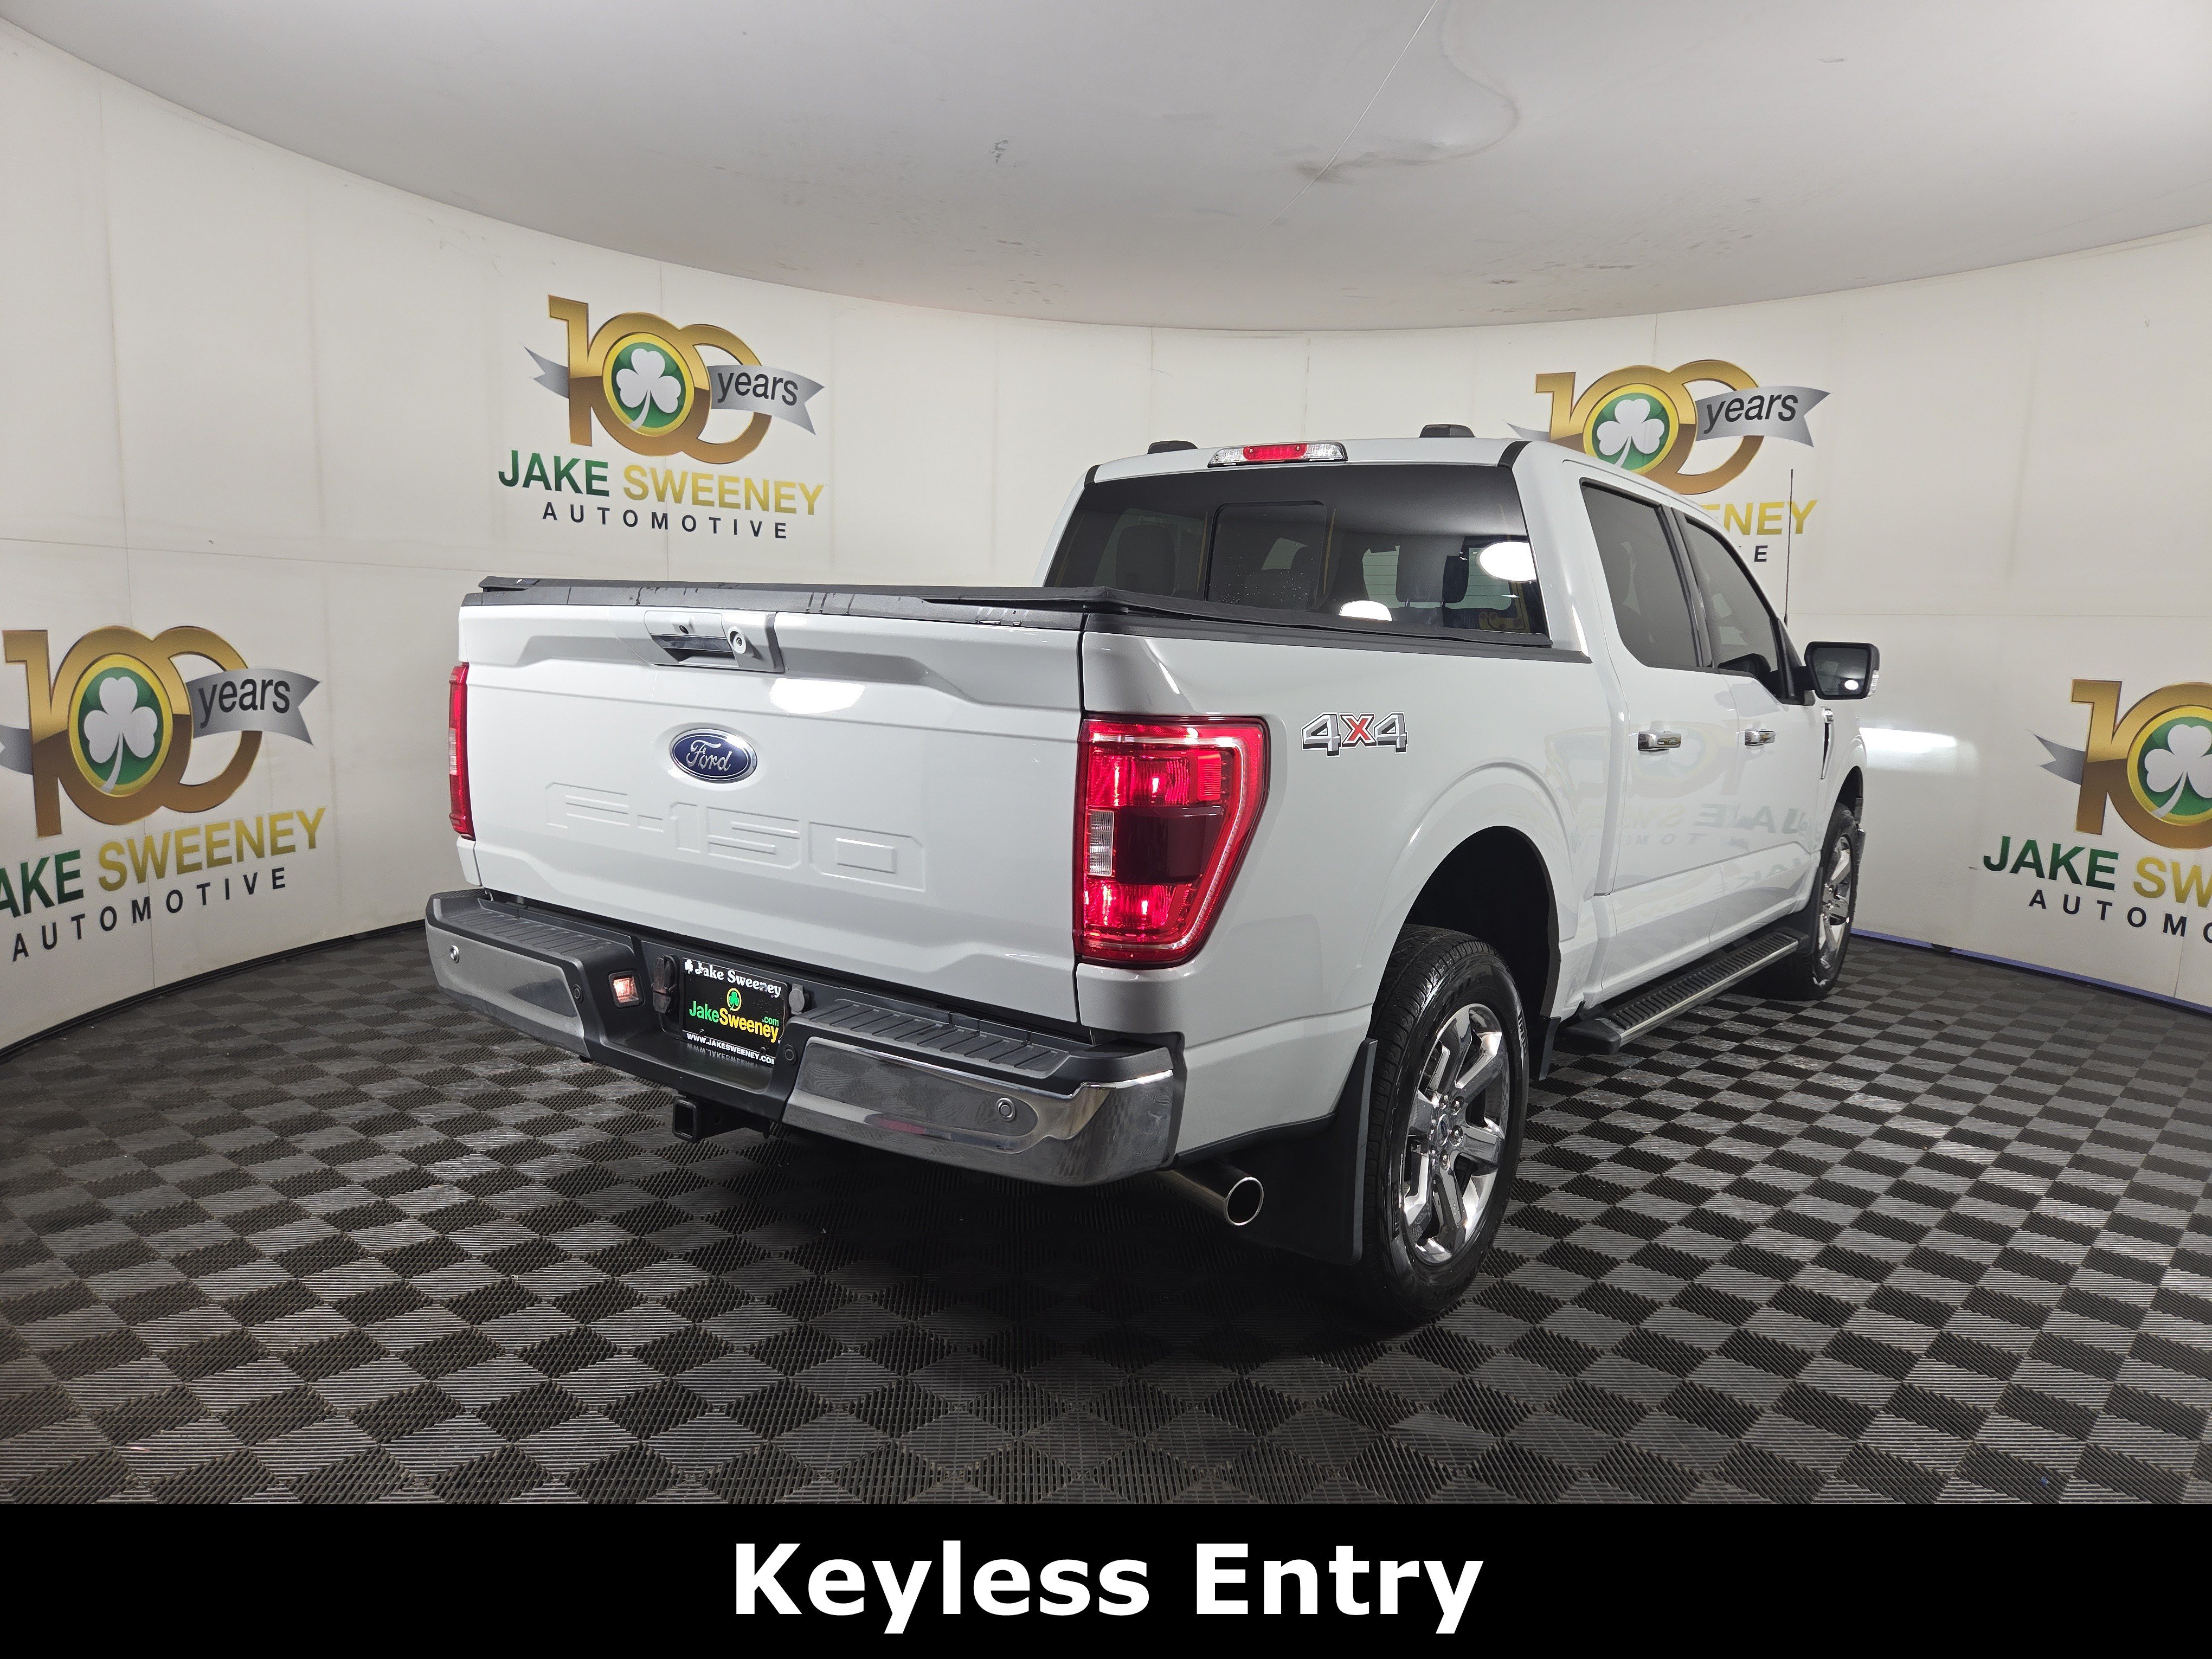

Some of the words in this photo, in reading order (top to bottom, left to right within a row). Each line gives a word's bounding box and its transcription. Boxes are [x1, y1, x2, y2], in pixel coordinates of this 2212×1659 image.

[717, 370, 798, 406] years
[1703, 390, 1799, 434] years
[498, 449, 610, 497] JAKE
[623, 465, 825, 516] SWEENEY
[542, 501, 787, 539] AUTOMOTIVE
[1702, 500, 1817, 536] NEY
[198, 678, 291, 729] years
[685, 739, 733, 774] Ford
[98, 807, 326, 892] SWEENEY
[545, 782, 926, 892] F-150
[1983, 835, 2119, 891] JAKE
[12, 867, 286, 962] AUTOMOTIVE
[695, 962, 724, 981] Jake
[727, 970, 782, 998] Sweeney
